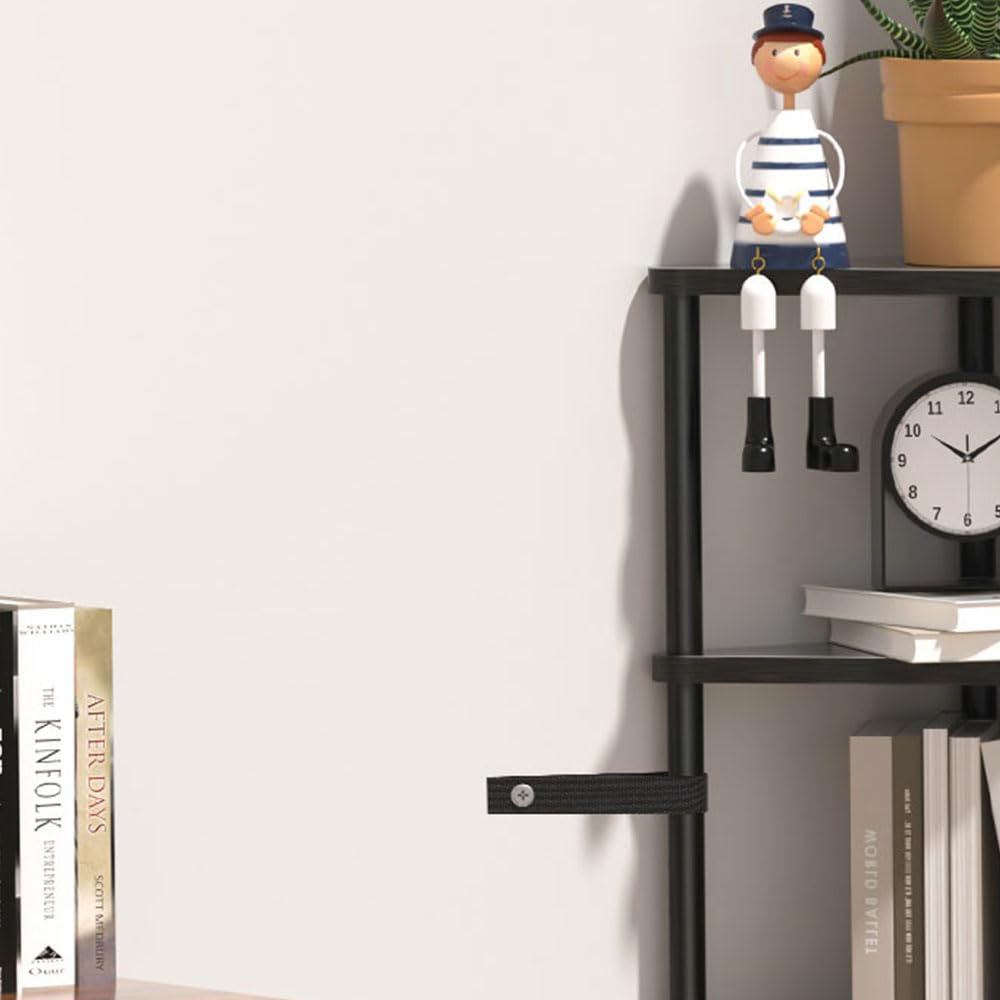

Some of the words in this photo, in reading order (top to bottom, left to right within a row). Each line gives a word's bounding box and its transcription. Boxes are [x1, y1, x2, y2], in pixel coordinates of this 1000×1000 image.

[957, 390, 975, 405] 12
[927, 401, 943, 415] 11
[904, 423, 921, 438] 10
[897, 453, 907, 468] 9
[908, 484, 918, 499] 8
[932, 507, 942, 521] 7
[963, 513, 972, 527] 6
[42, 688, 54, 707] THE
[87, 694, 105, 767] AFTER
[34, 719, 62, 832] KINFOLK
[87, 776, 107, 833] DAYS
[95, 874, 105, 910] SCOTT
